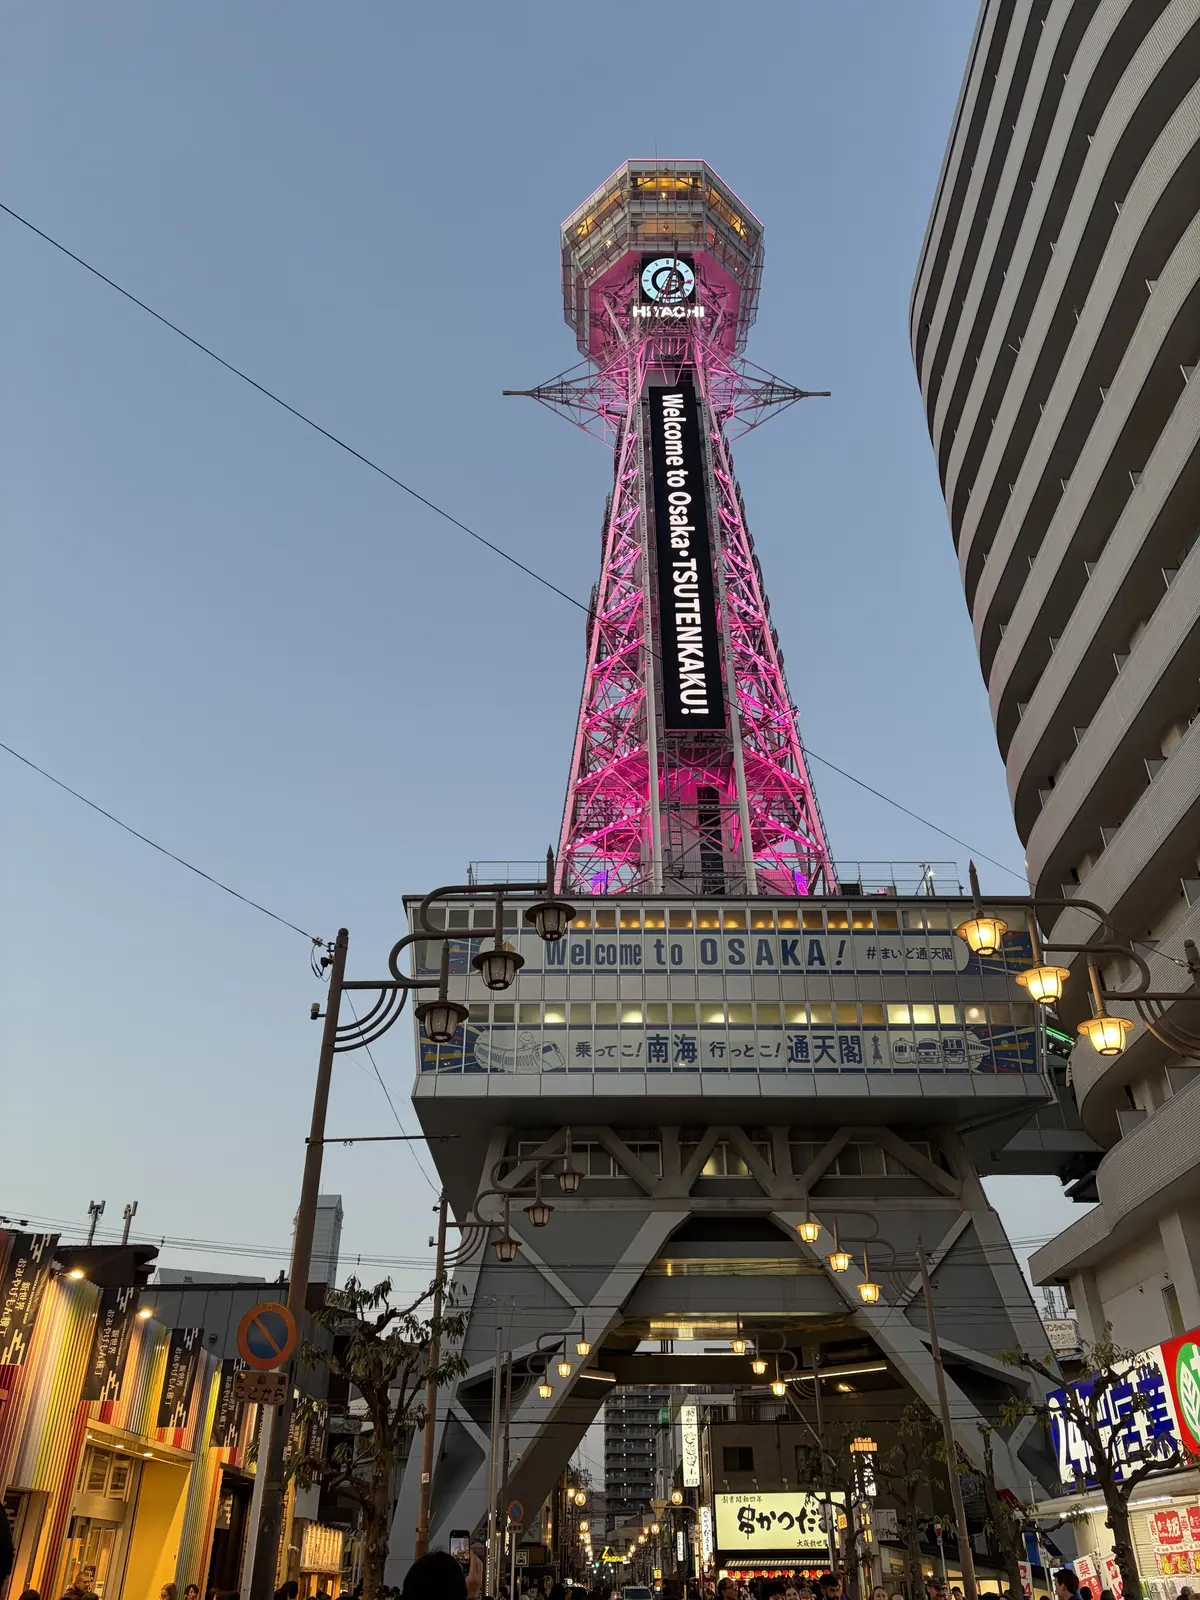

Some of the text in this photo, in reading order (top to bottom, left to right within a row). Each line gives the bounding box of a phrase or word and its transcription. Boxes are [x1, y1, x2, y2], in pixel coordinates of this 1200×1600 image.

[662, 393, 687, 466] Welcome
[666, 469, 689, 488] to
[546, 938, 642, 966] Welcome
[654, 938, 683, 966] to
[866, 946, 953, 960] #まいど通天閣
[787, 1034, 863, 1065] 通天閣
[235, 1386, 285, 1402] ここから
